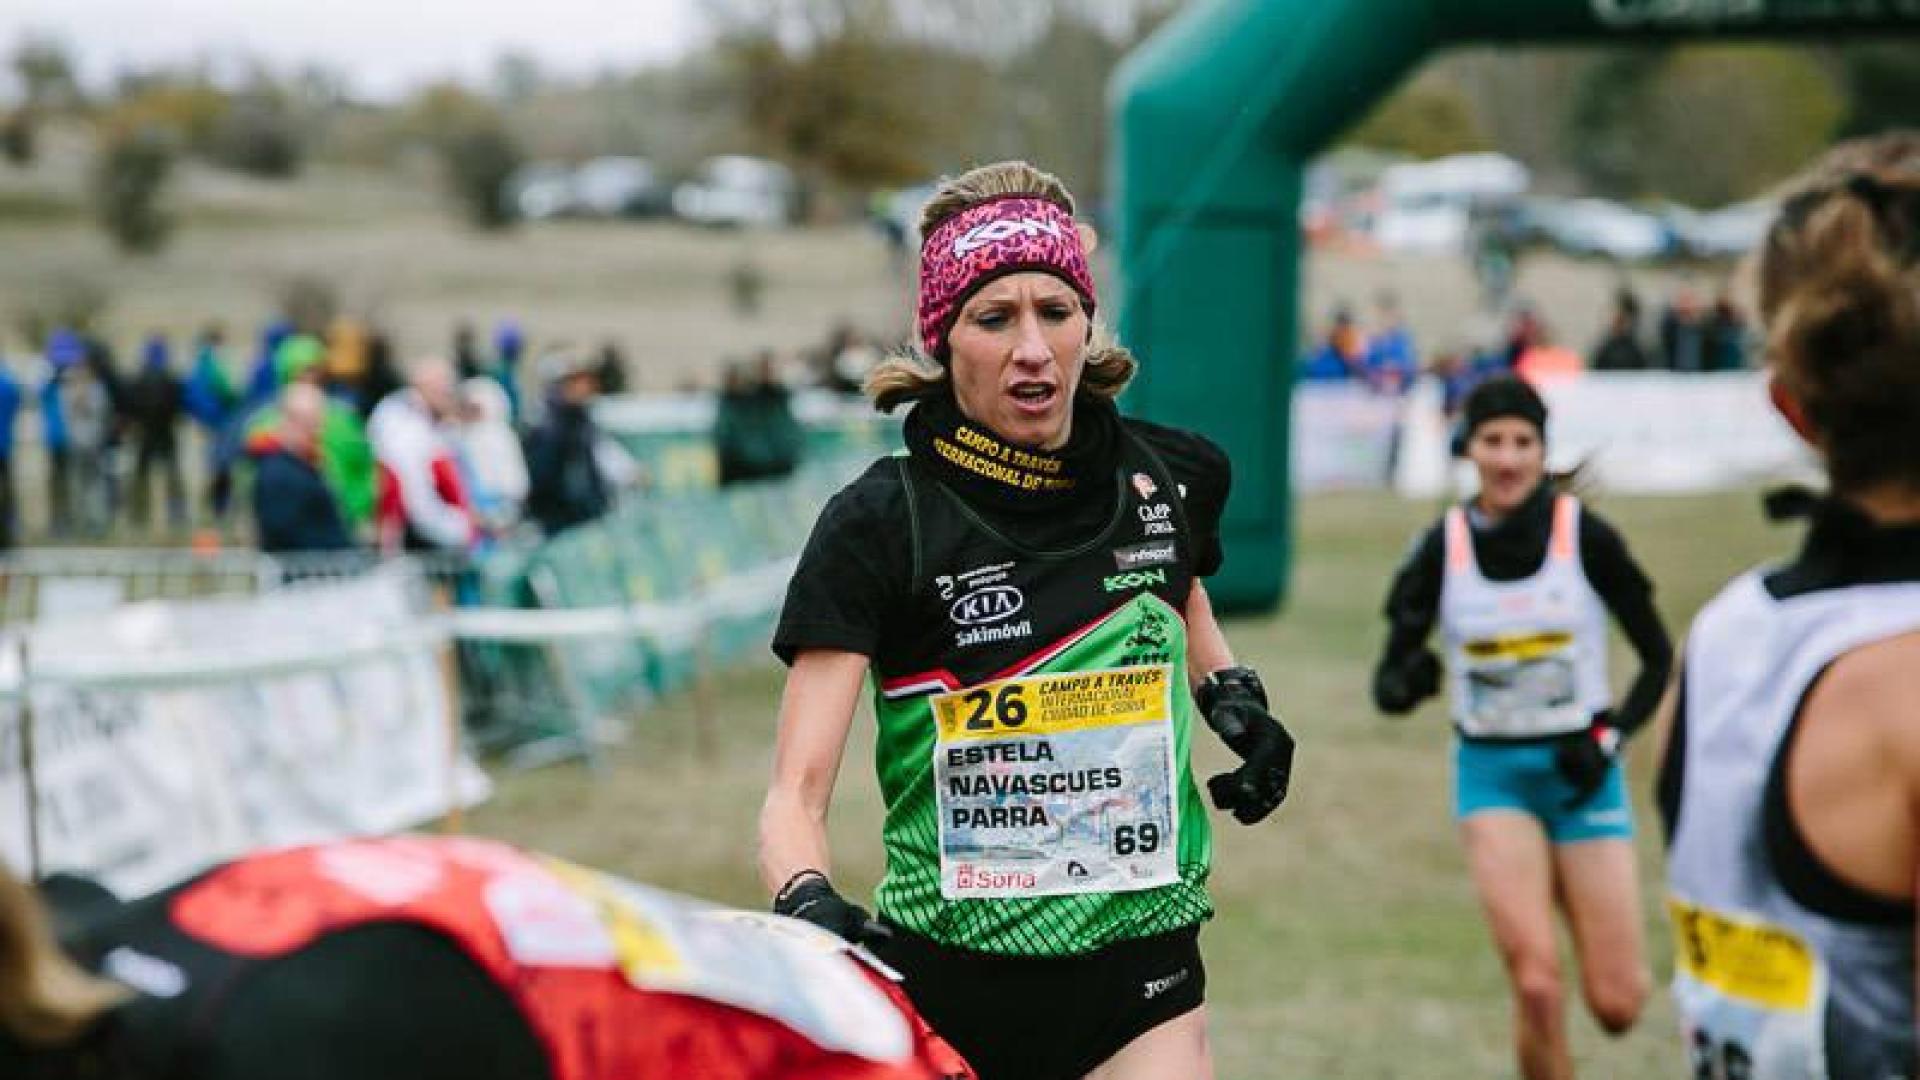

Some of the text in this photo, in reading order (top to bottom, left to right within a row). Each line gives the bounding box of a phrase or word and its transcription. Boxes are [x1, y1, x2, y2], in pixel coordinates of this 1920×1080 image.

[954, 426, 999, 456] CAMPO
[1000, 446, 1011, 462] A
[963, 591, 1013, 621] KIA
[963, 684, 1028, 730] 26
[1039, 678, 1091, 696] CAMPO
[1093, 676, 1104, 689] A
[947, 741, 1054, 768] ESTELA
[950, 767, 1122, 797] NAVASCUES
[952, 806, 1049, 829] PARRA
[1114, 822, 1160, 855] 69
[976, 869, 1037, 889] Soria
